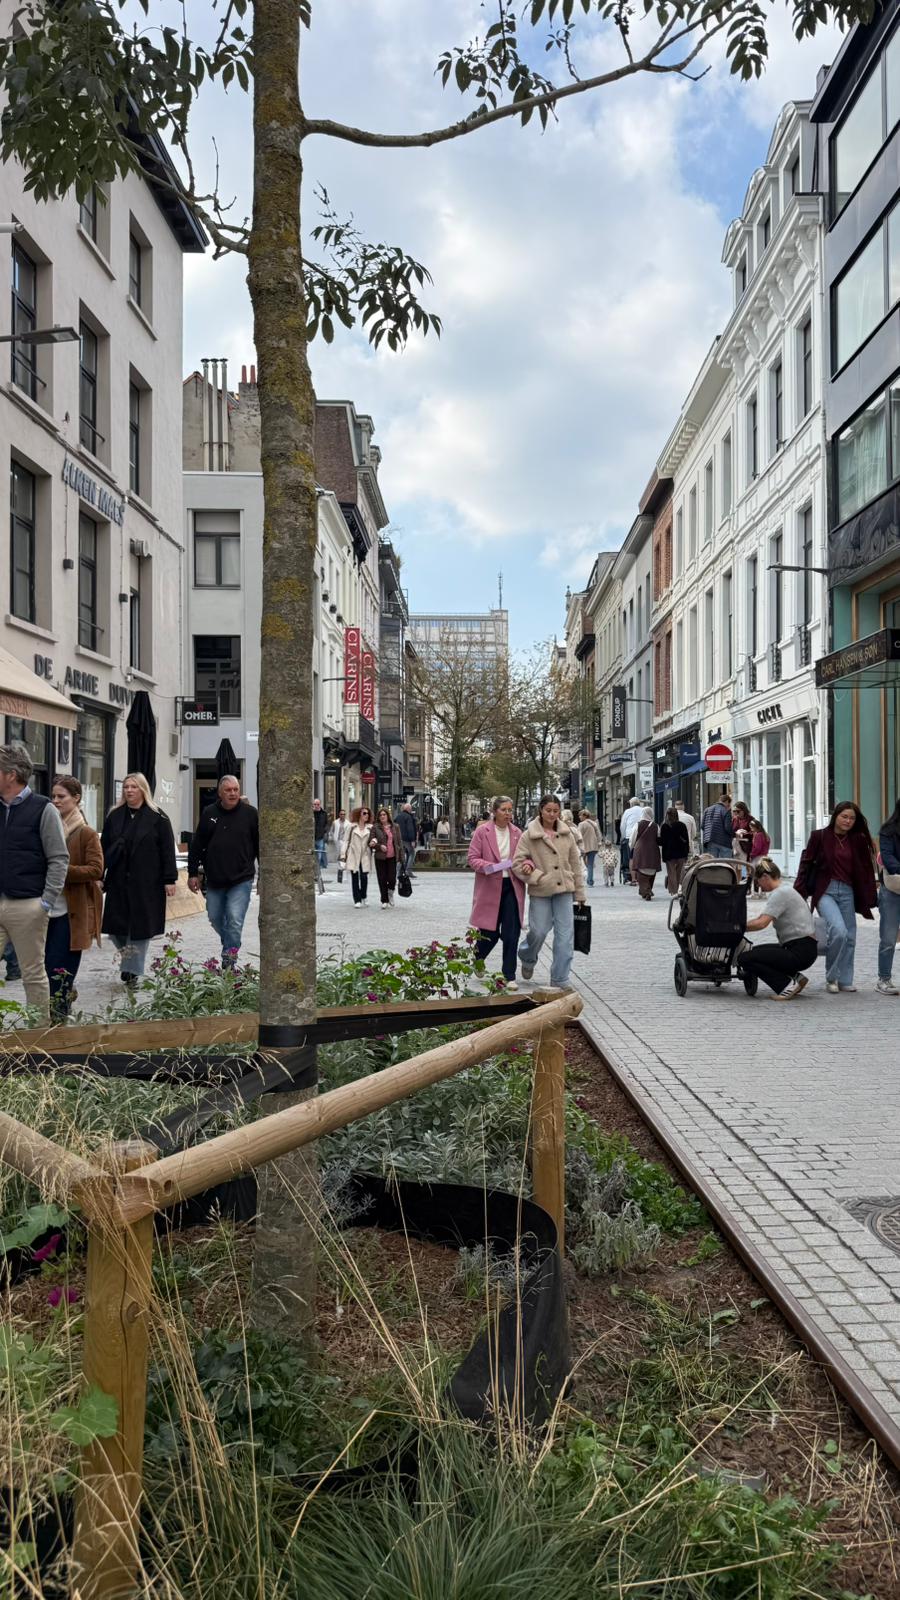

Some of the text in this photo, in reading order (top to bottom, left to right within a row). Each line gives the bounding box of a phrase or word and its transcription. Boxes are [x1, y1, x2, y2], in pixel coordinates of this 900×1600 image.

[34, 654, 53, 680] DE
[65, 666, 99, 695] ARME
[347, 630, 358, 701] CLARINS
[363, 654, 373, 717] CLARINS
[184, 711, 216, 720] OMER.
